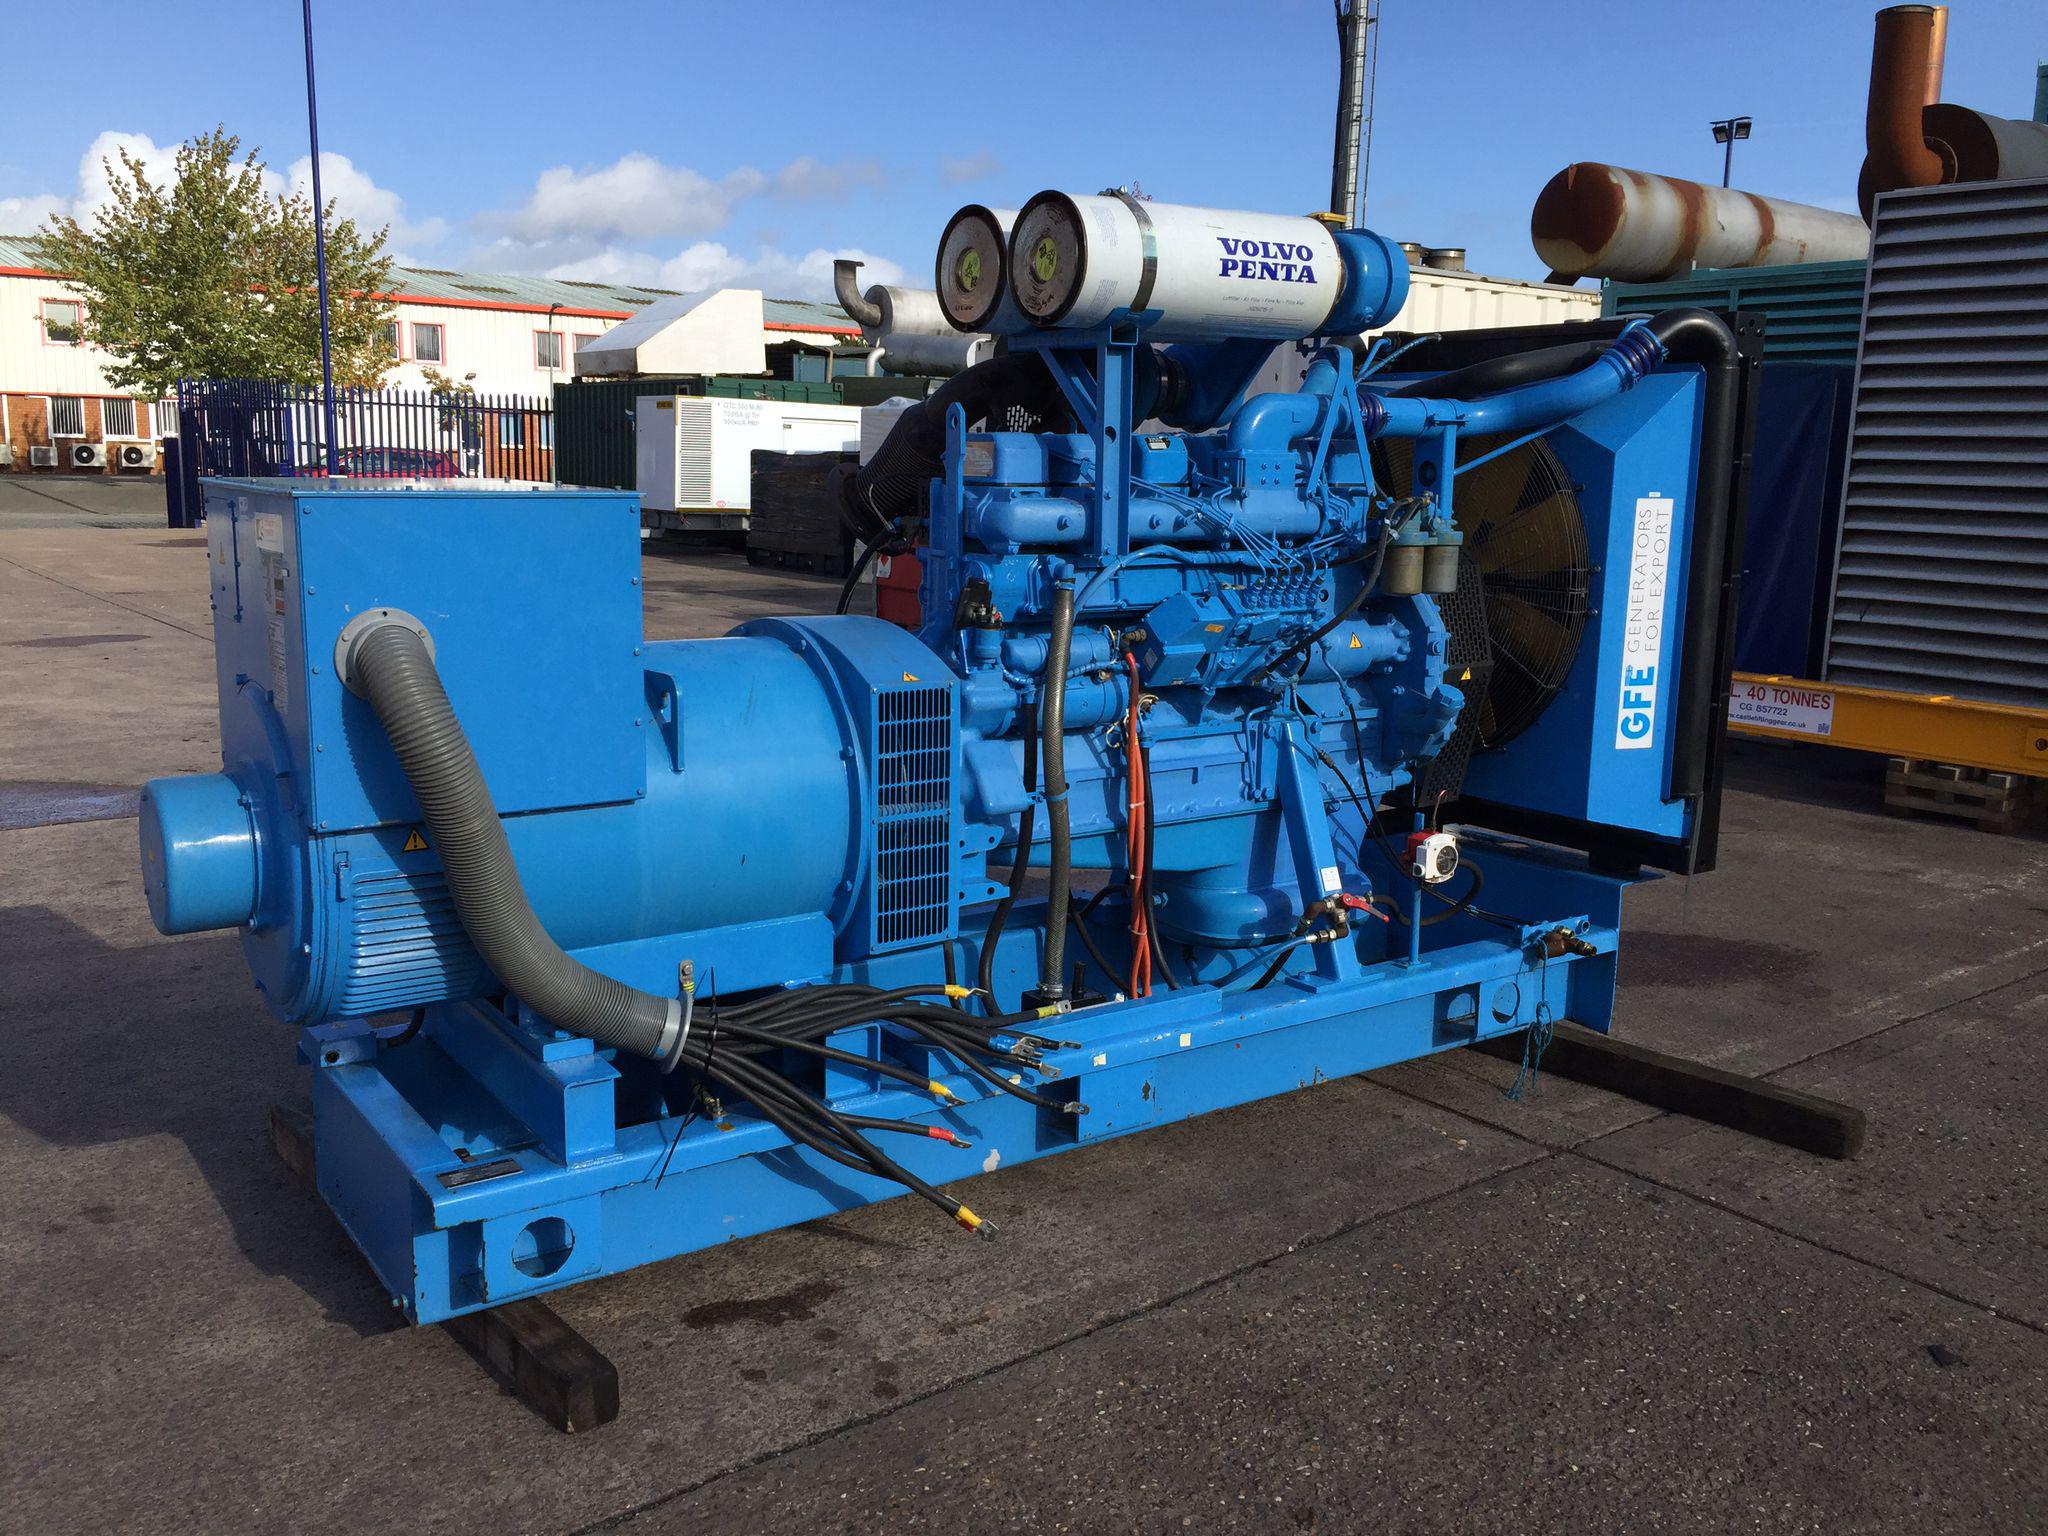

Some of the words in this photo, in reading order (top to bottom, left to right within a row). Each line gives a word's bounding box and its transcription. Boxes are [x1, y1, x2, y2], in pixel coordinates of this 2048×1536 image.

[1216, 237, 1314, 262] VOLVO
[1219, 258, 1318, 284] PENTA
[1650, 508, 1670, 598] EXPORT
[1627, 509, 1652, 653] GENERATORS
[1645, 609, 1661, 651] FOR
[1620, 665, 1655, 740] GFE
[1739, 702, 1753, 711] CG
[1755, 705, 1788, 717] 857722
[1747, 686, 1767, 701] 40
[1772, 688, 1832, 710] TONNES
